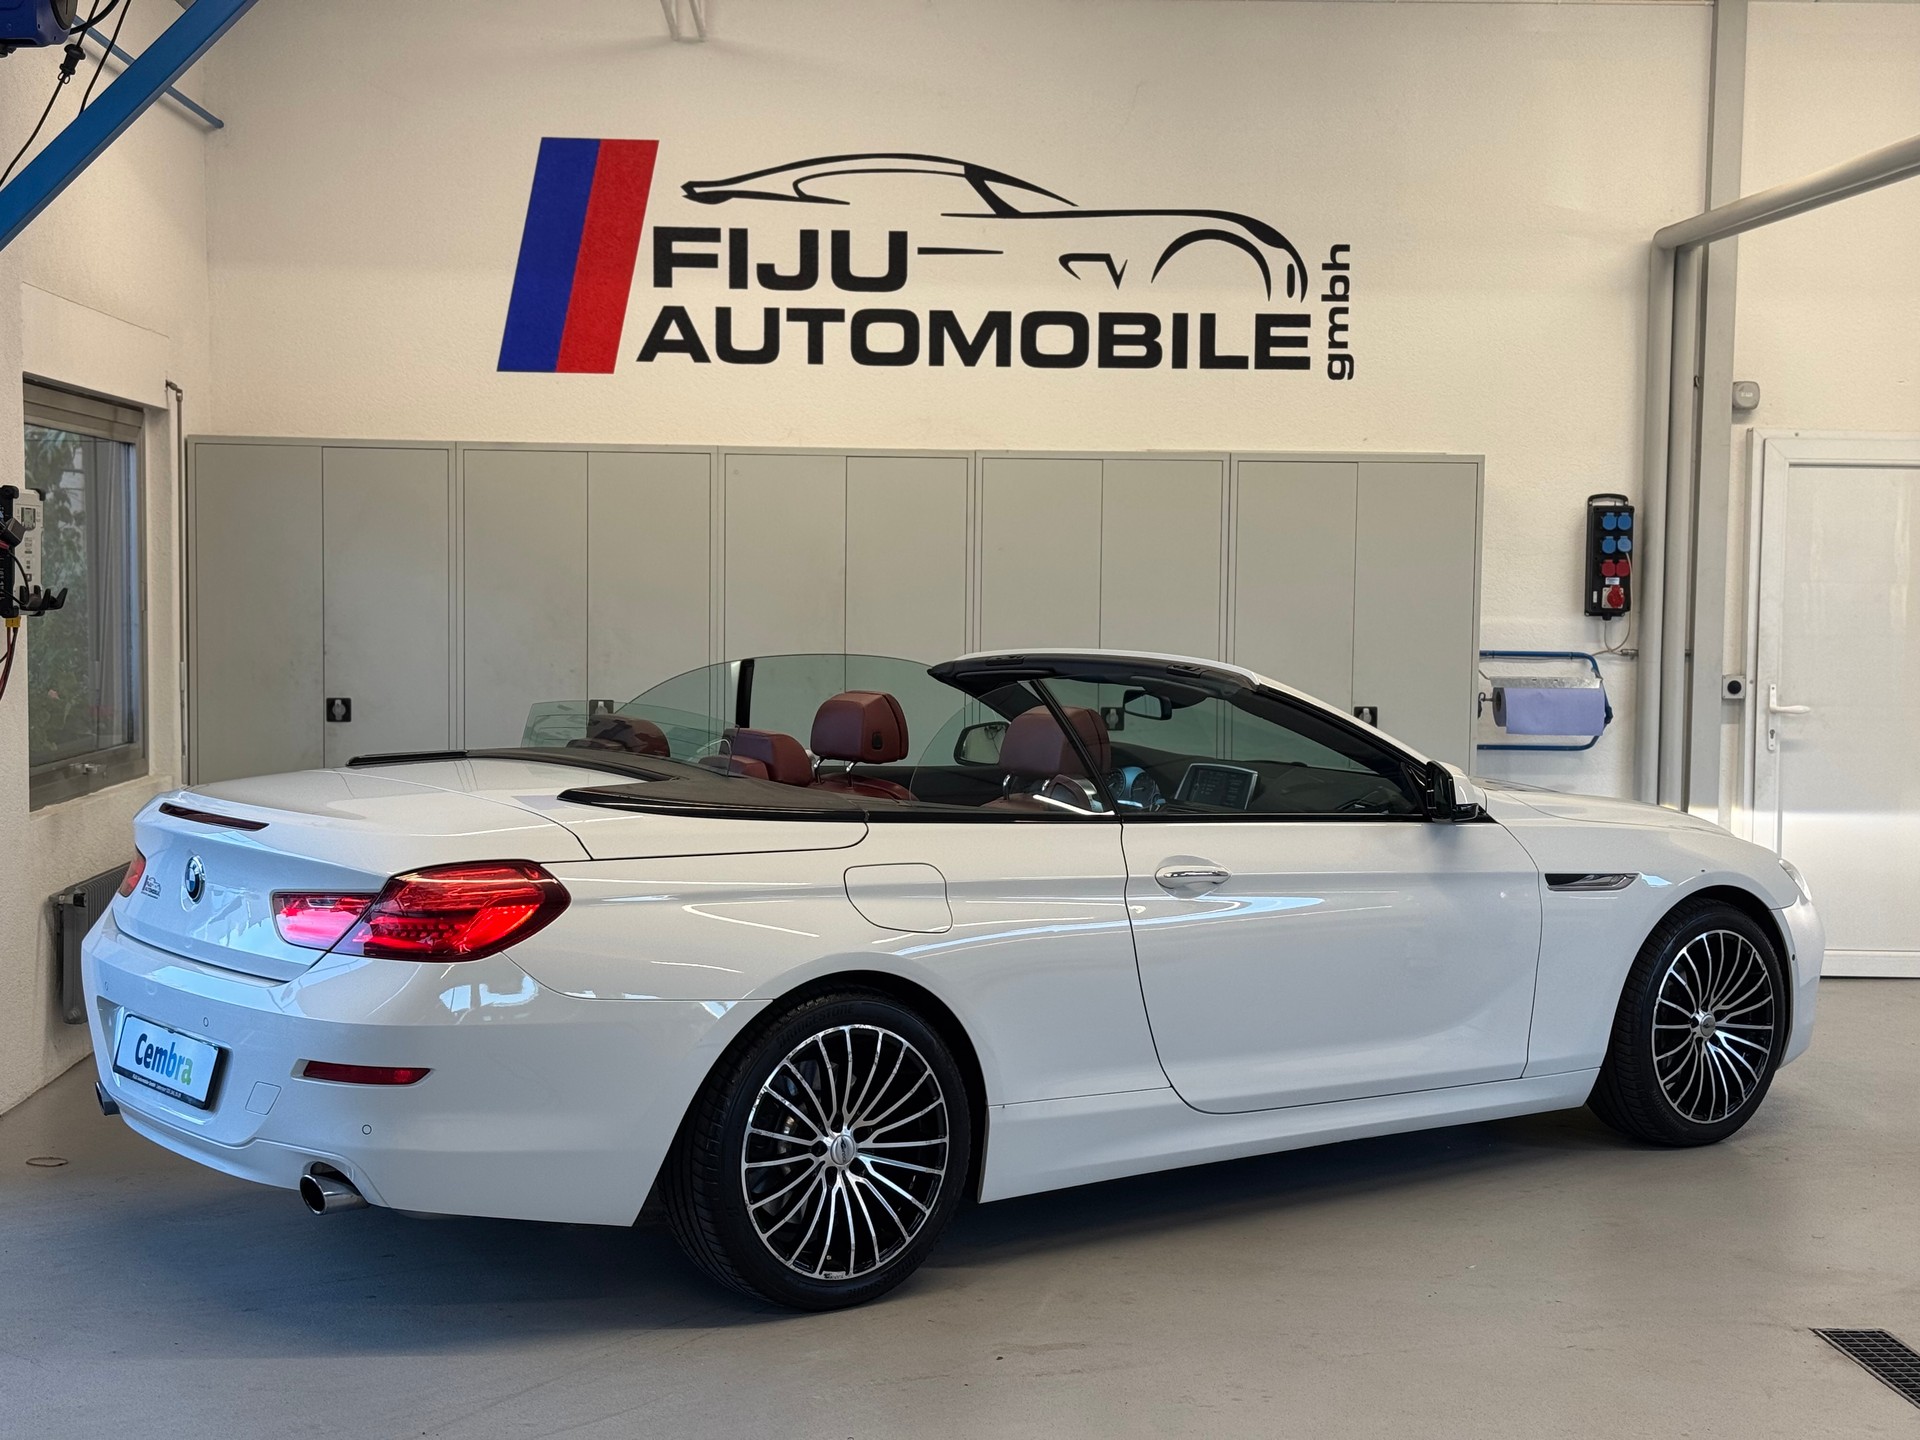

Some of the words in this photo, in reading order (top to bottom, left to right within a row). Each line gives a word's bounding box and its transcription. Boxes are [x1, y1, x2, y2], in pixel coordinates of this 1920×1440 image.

[653, 226, 908, 293] FIJU
[636, 305, 1311, 370] AUTOMOBILE
[1321, 243, 1355, 381] gmbh
[134, 1033, 194, 1086] Cembra
